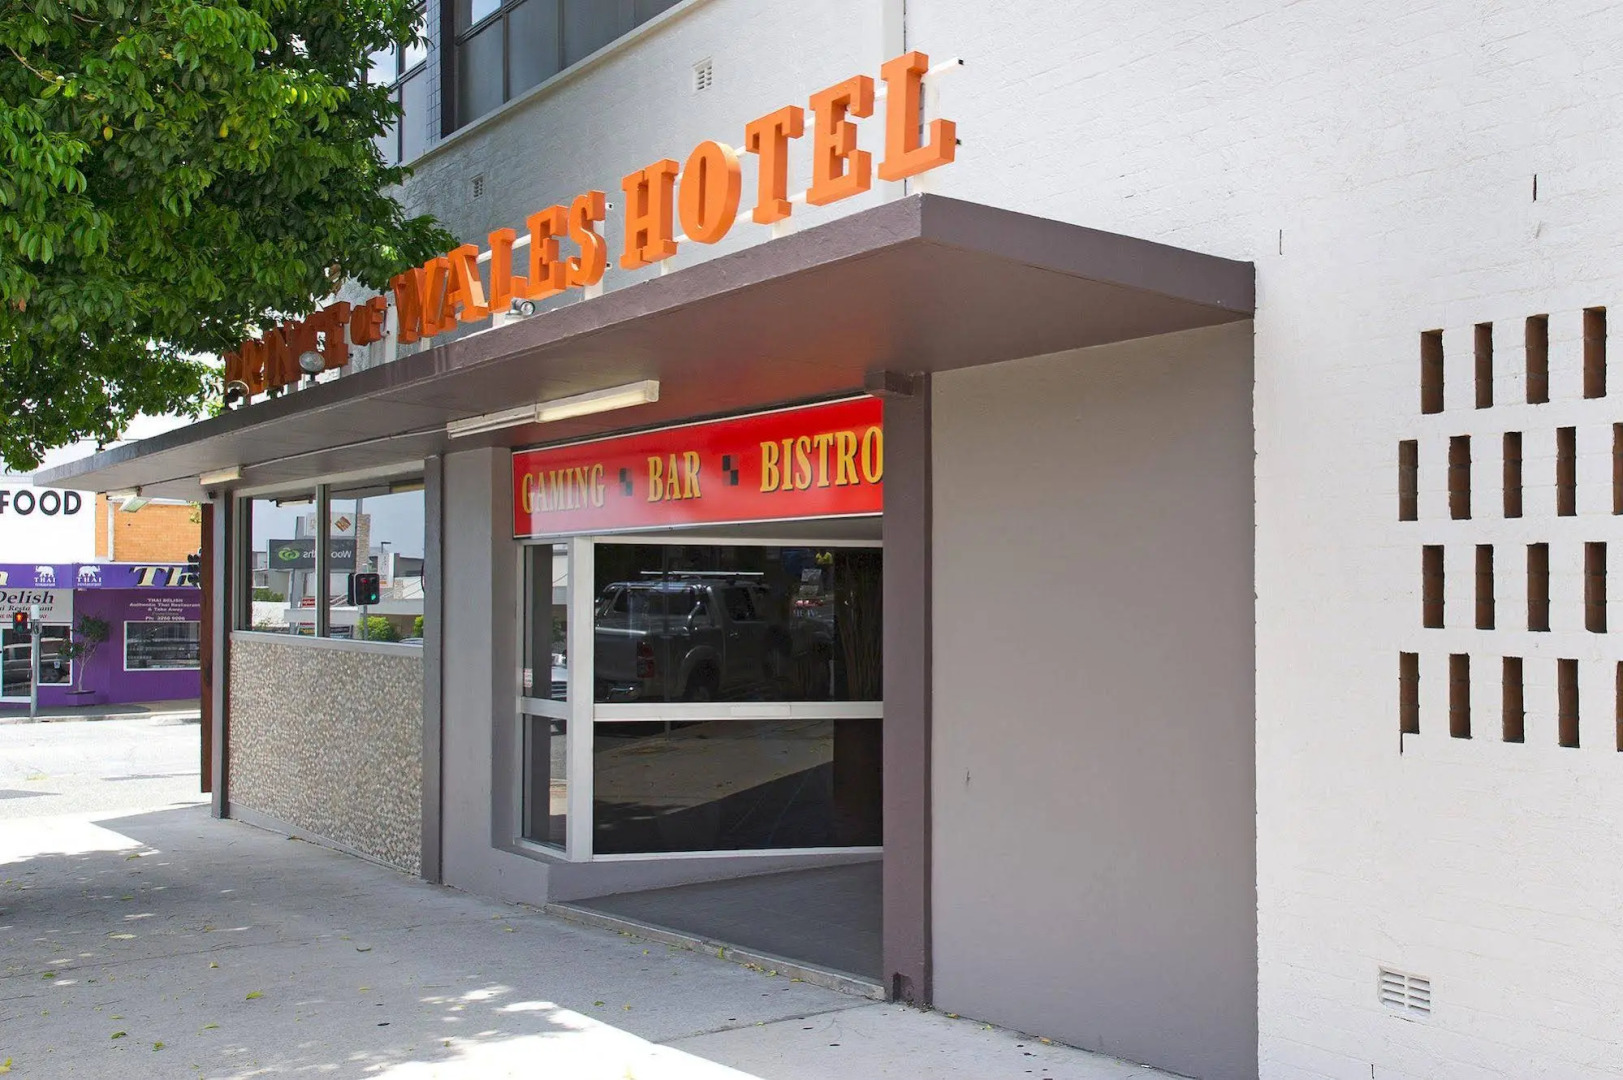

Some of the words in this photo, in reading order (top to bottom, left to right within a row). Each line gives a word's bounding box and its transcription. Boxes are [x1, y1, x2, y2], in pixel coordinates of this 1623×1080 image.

[390, 190, 607, 344] WALES
[620, 51, 956, 270] HOTEL
[0, 490, 82, 515] FOOD
[522, 464, 604, 514] GAMING
[647, 451, 701, 502] BAR
[760, 426, 883, 493] BISTRO
